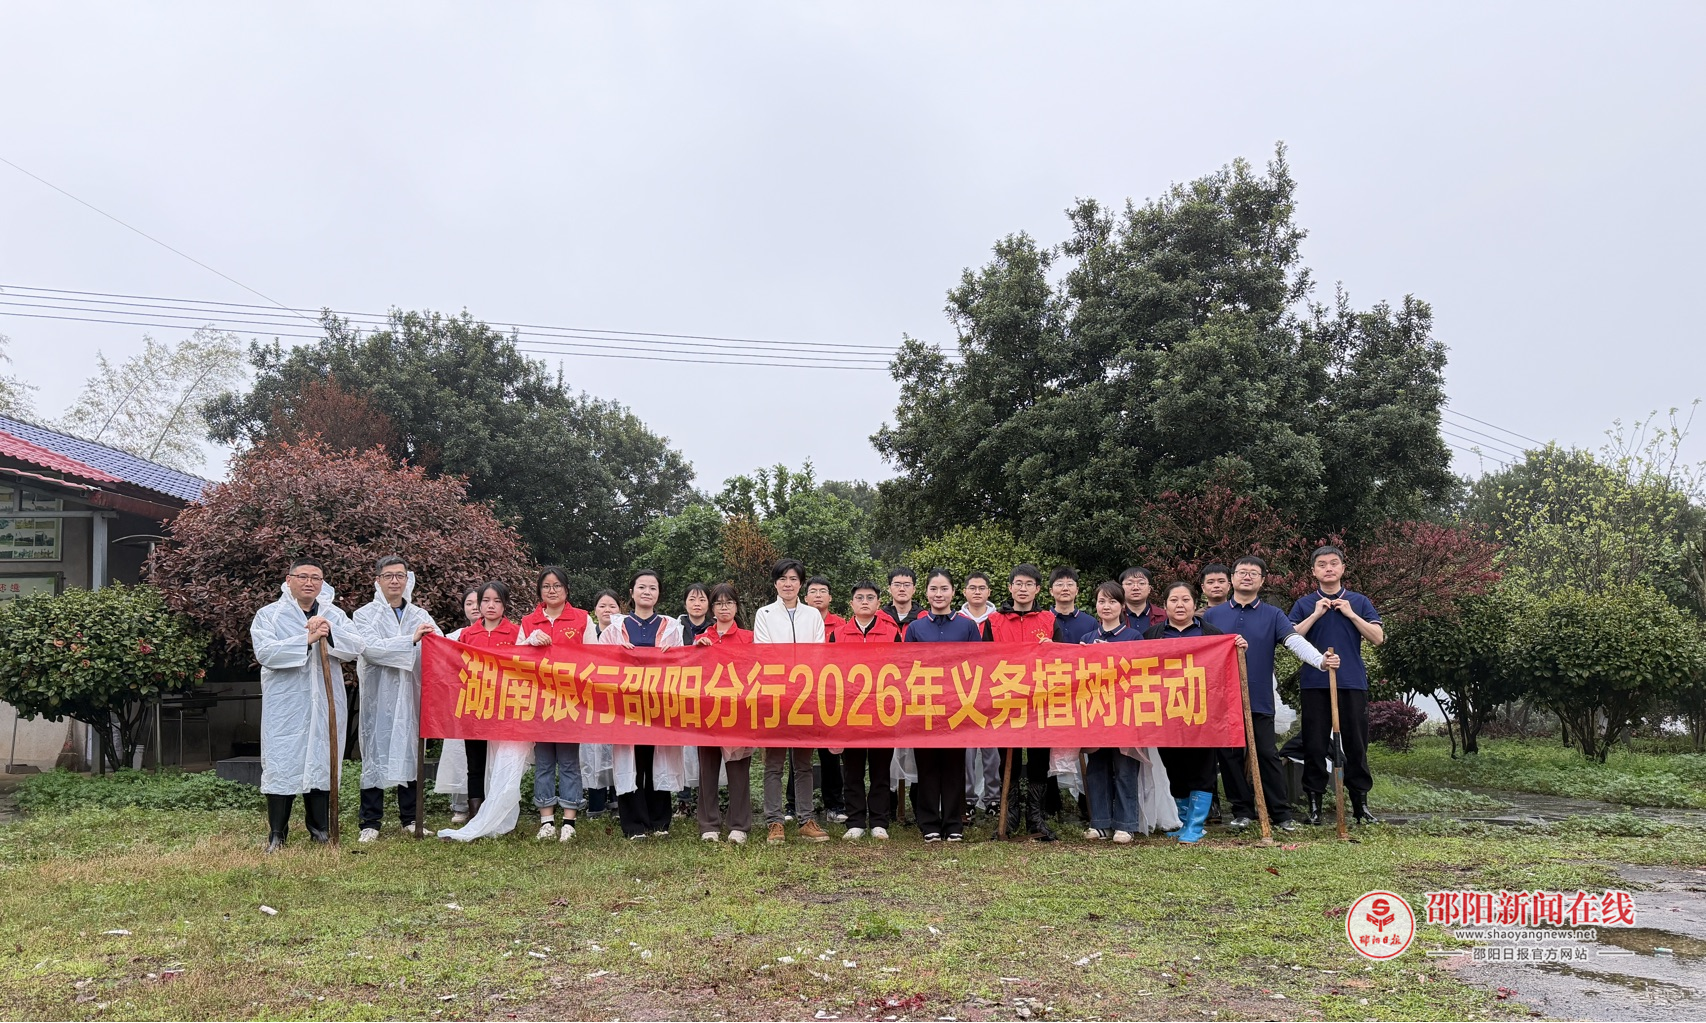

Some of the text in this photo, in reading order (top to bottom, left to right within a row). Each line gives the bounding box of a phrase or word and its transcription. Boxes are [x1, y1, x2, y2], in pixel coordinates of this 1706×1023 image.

[455, 649, 1208, 731] 湖南银行邵阳分行2026年义务植树活动
